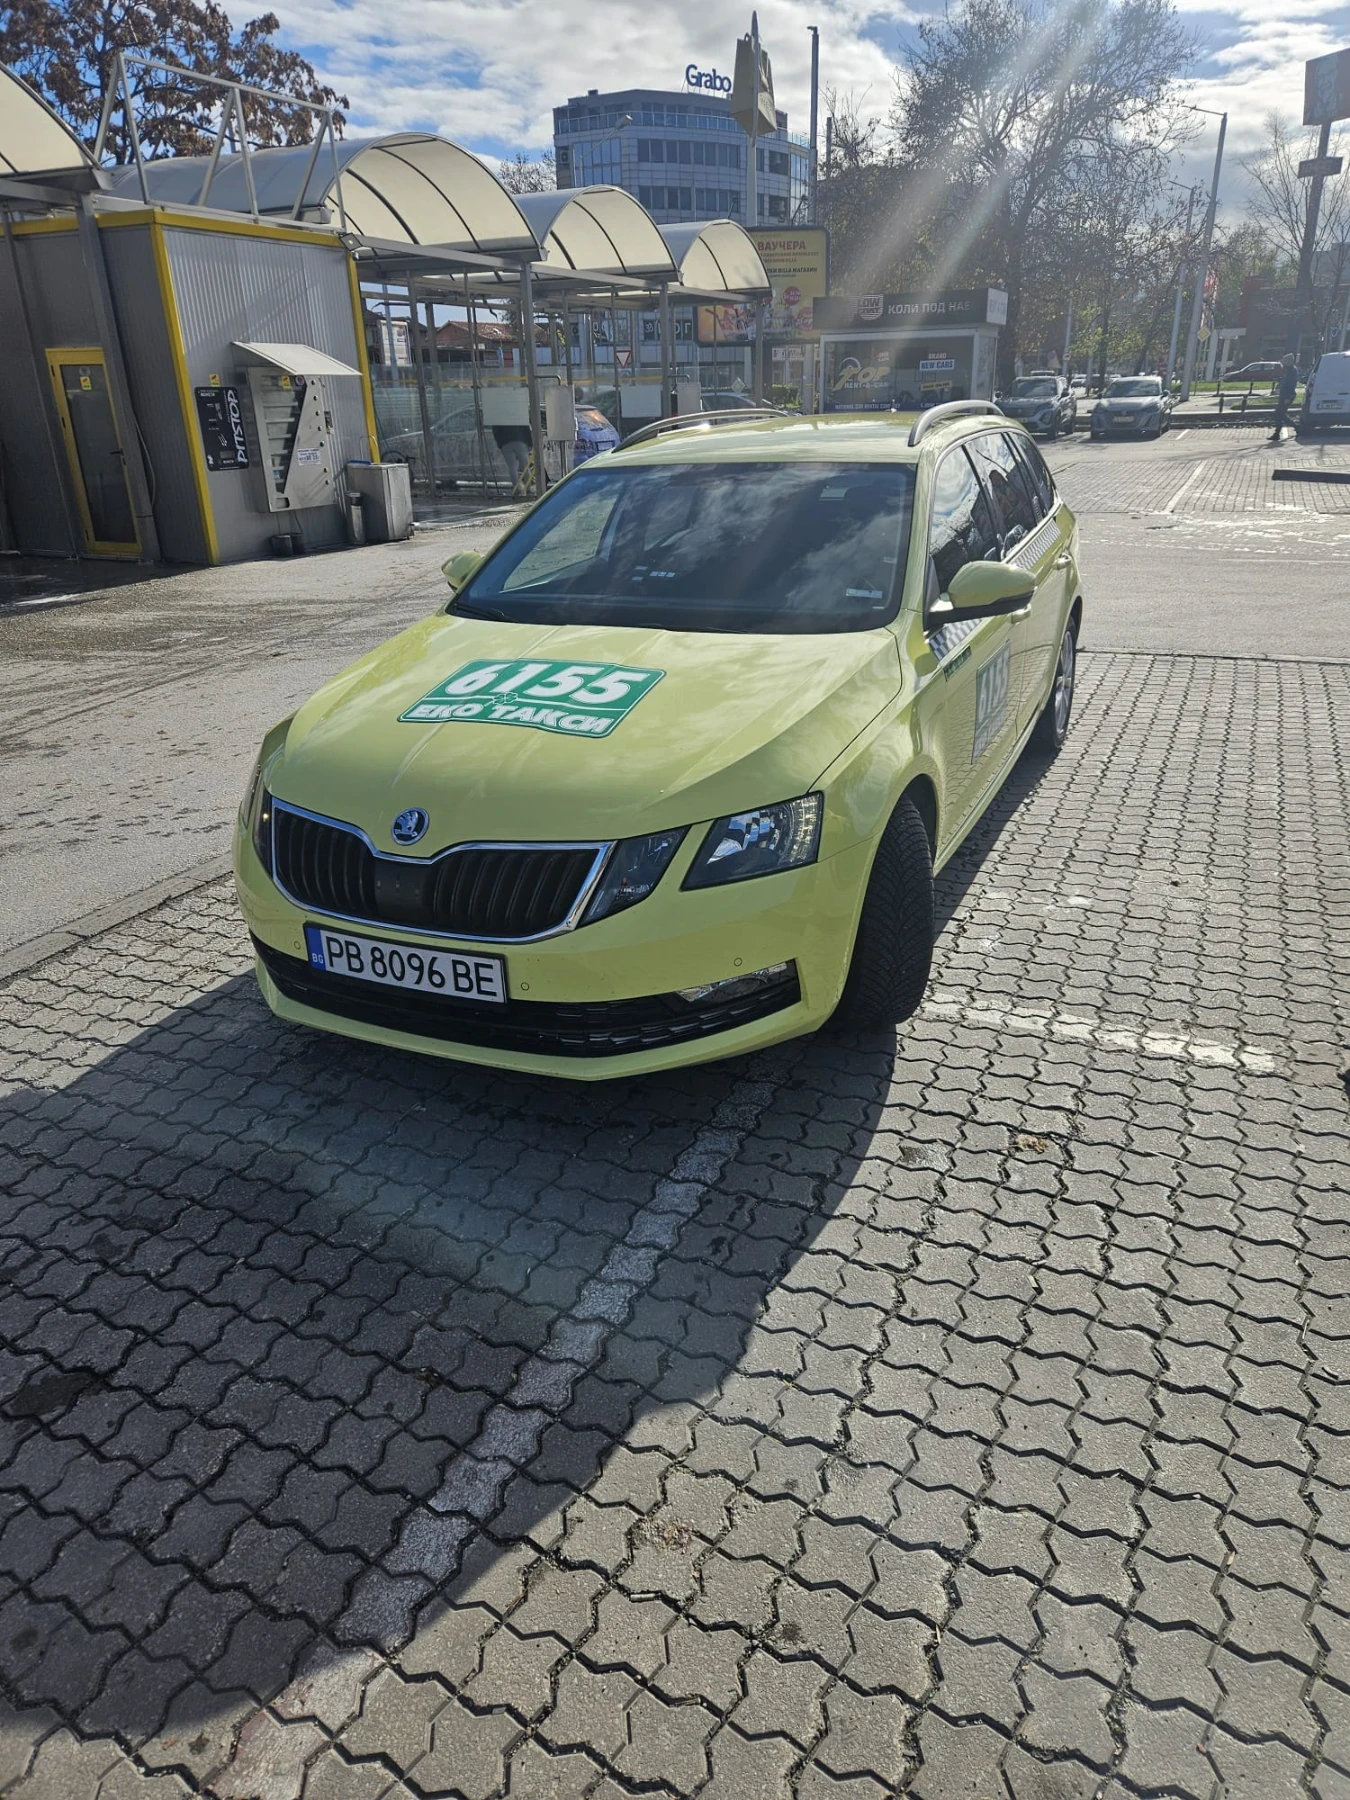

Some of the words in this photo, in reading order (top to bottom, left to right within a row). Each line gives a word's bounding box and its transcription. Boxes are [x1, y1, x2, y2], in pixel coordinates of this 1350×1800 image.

[686, 63, 732, 92] Grabo
[758, 240, 806, 251] ВАУЧЕРА
[858, 297, 880, 307] LOW
[888, 303, 919, 314] КОЛИ
[922, 302, 946, 314] ПОД
[921, 361, 935, 369] NEW
[936, 360, 953, 368] CARS
[832, 366, 890, 391] TOP
[445, 662, 650, 705] 6155
[407, 703, 484, 719] ЕКО
[489, 705, 615, 734] ТАКСИ
[311, 952, 324, 964] BG
[325, 936, 365, 974] PB
[370, 946, 446, 989] 8096
[451, 959, 498, 997] BE
